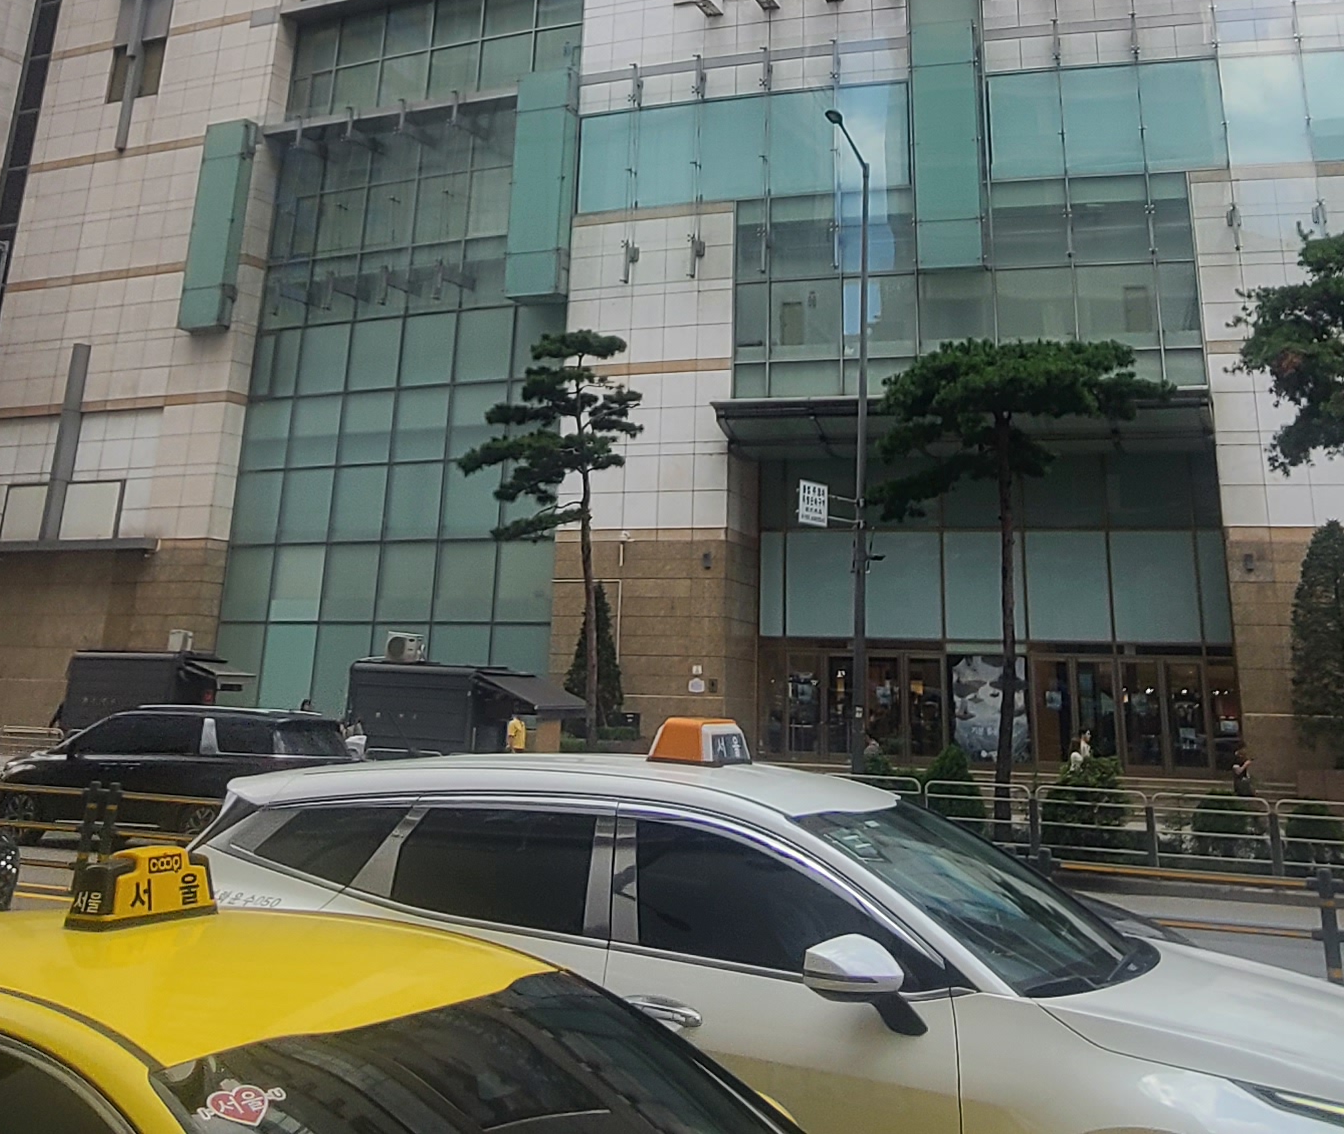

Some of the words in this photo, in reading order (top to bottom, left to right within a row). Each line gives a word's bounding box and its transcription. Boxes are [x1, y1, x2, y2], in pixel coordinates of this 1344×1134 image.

[73, 890, 102, 913] 서울
[129, 873, 200, 911] 서울
[219, 1091, 265, 1114] 서울
